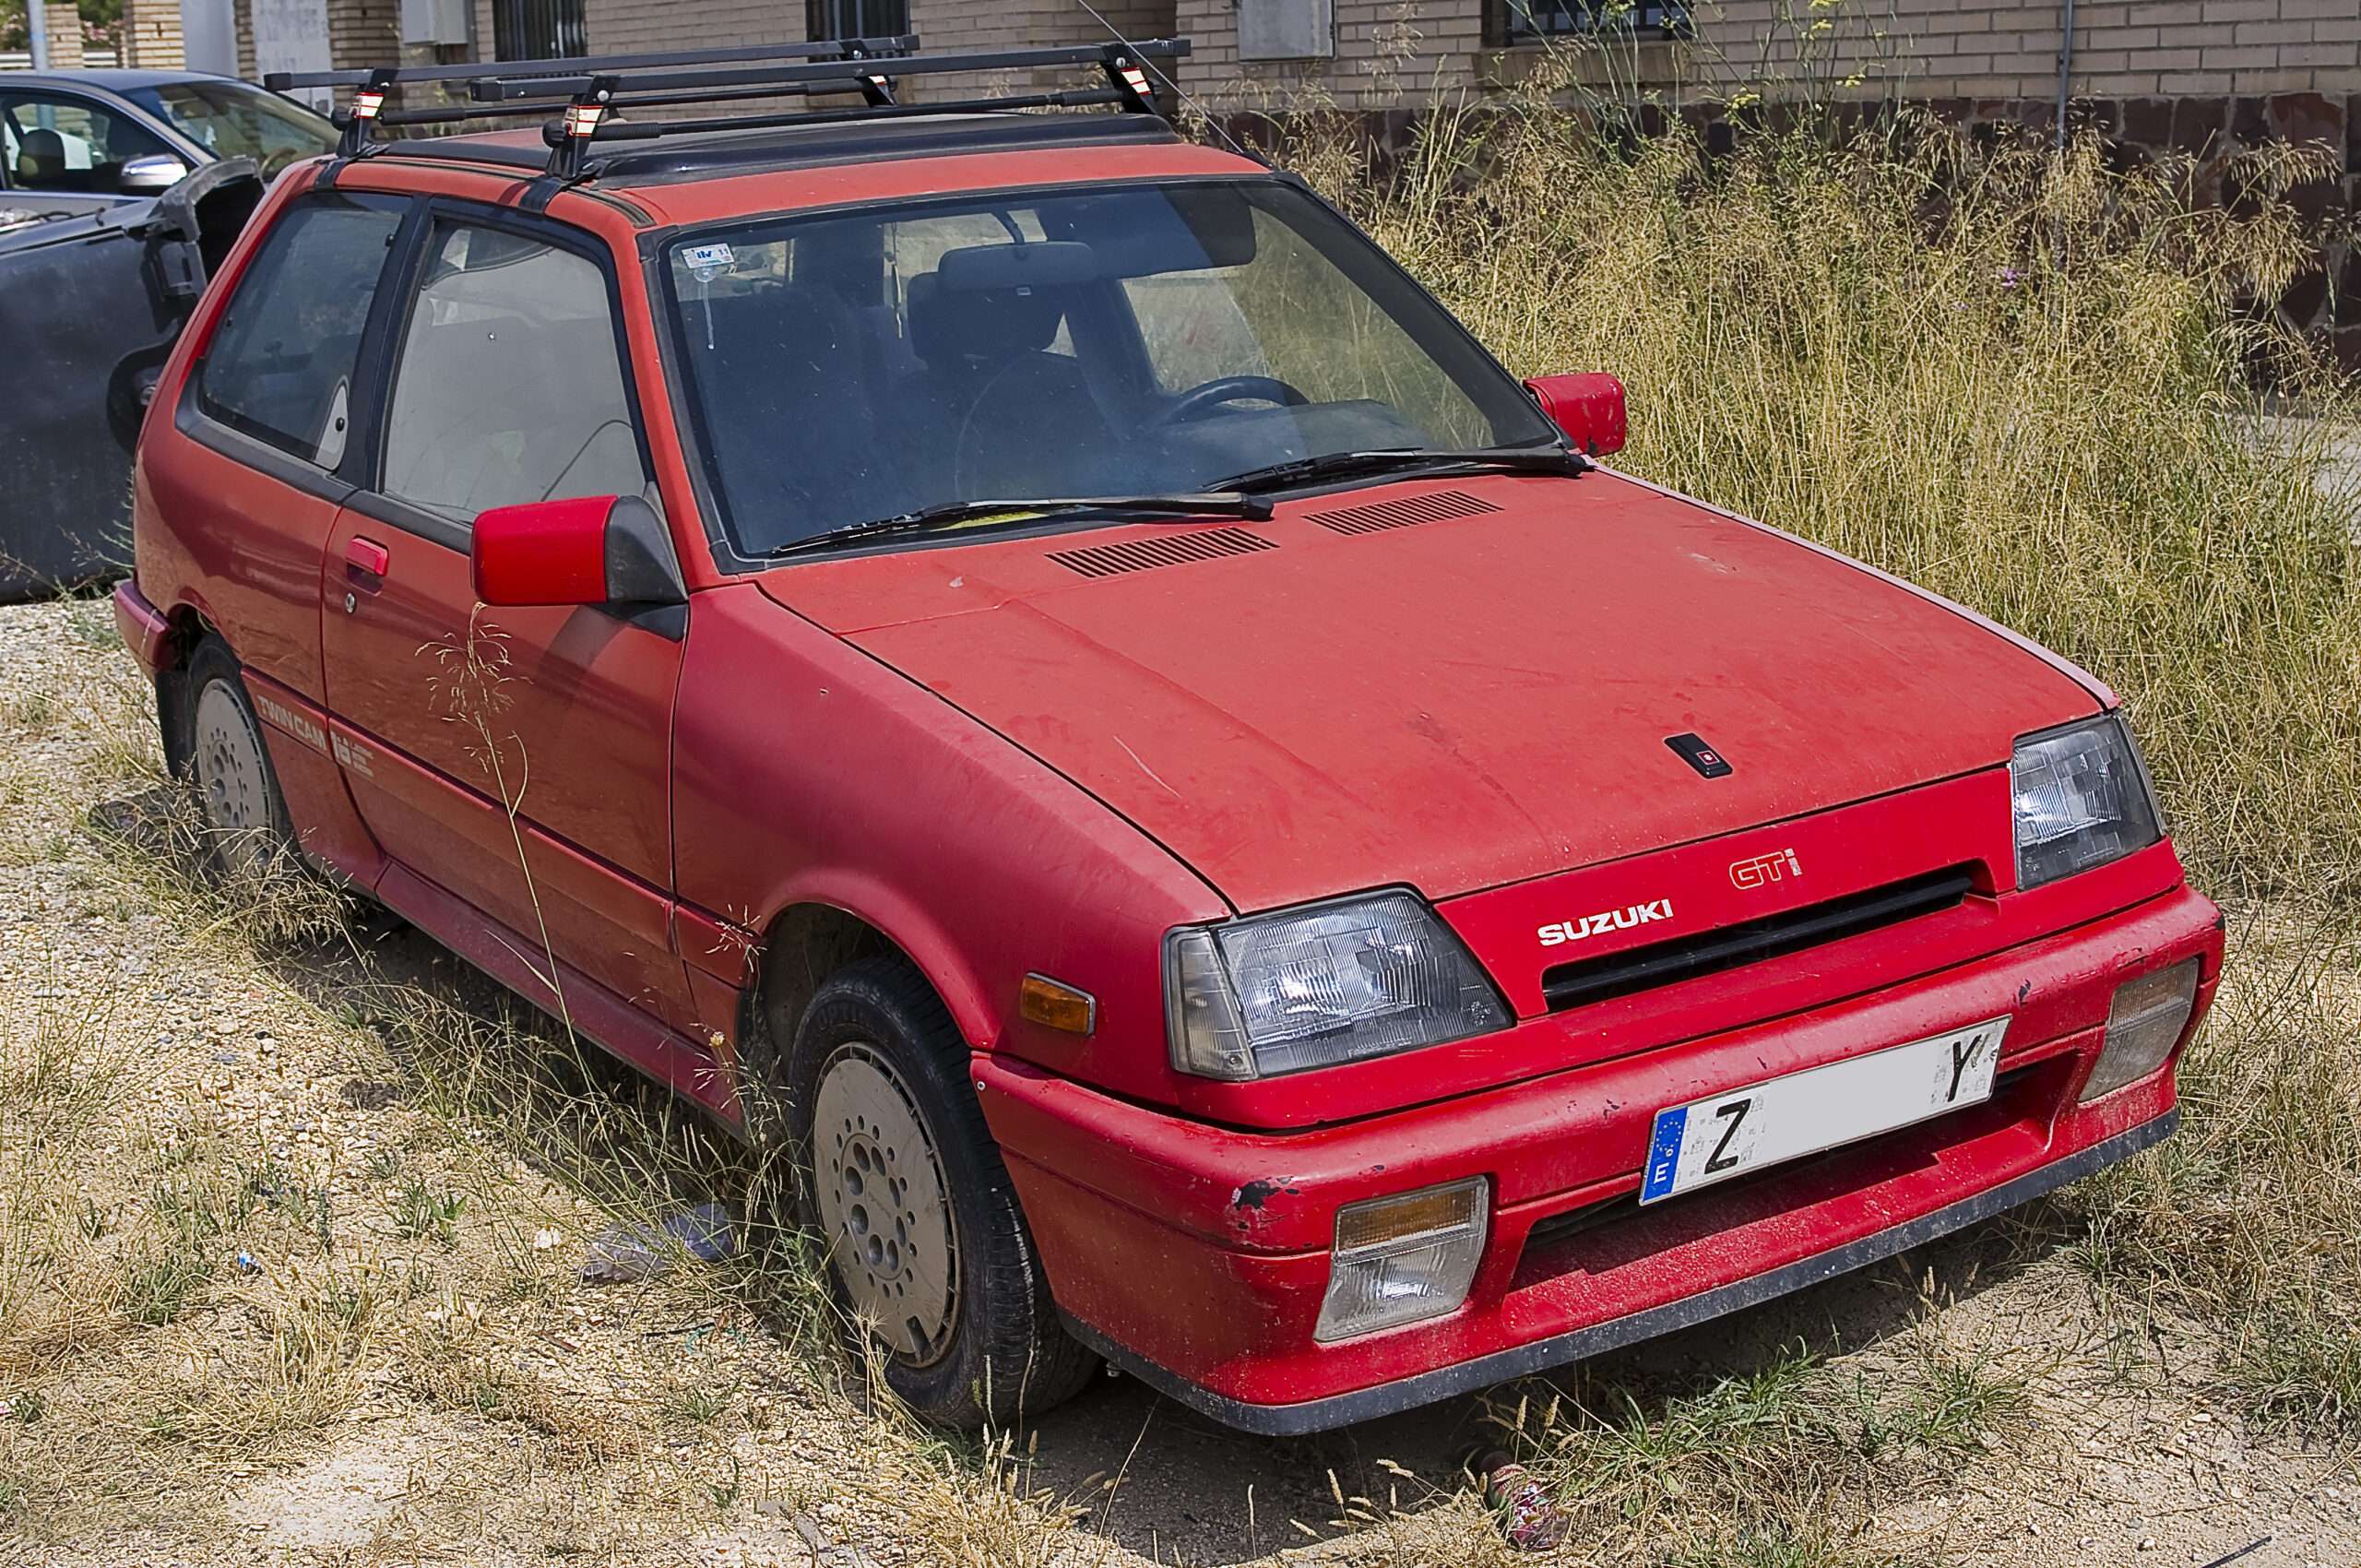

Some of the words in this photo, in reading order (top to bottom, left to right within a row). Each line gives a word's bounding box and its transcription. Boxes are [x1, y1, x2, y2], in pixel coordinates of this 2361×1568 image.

[257, 695, 294, 731] TWIN
[293, 715, 327, 752] CAM
[1728, 848, 1802, 890] GTi
[1537, 898, 1675, 946] SUZUKI
[1704, 1098, 1751, 1175] Z
[1947, 1034, 1982, 1102] Y
[1653, 1162, 1669, 1184] E
